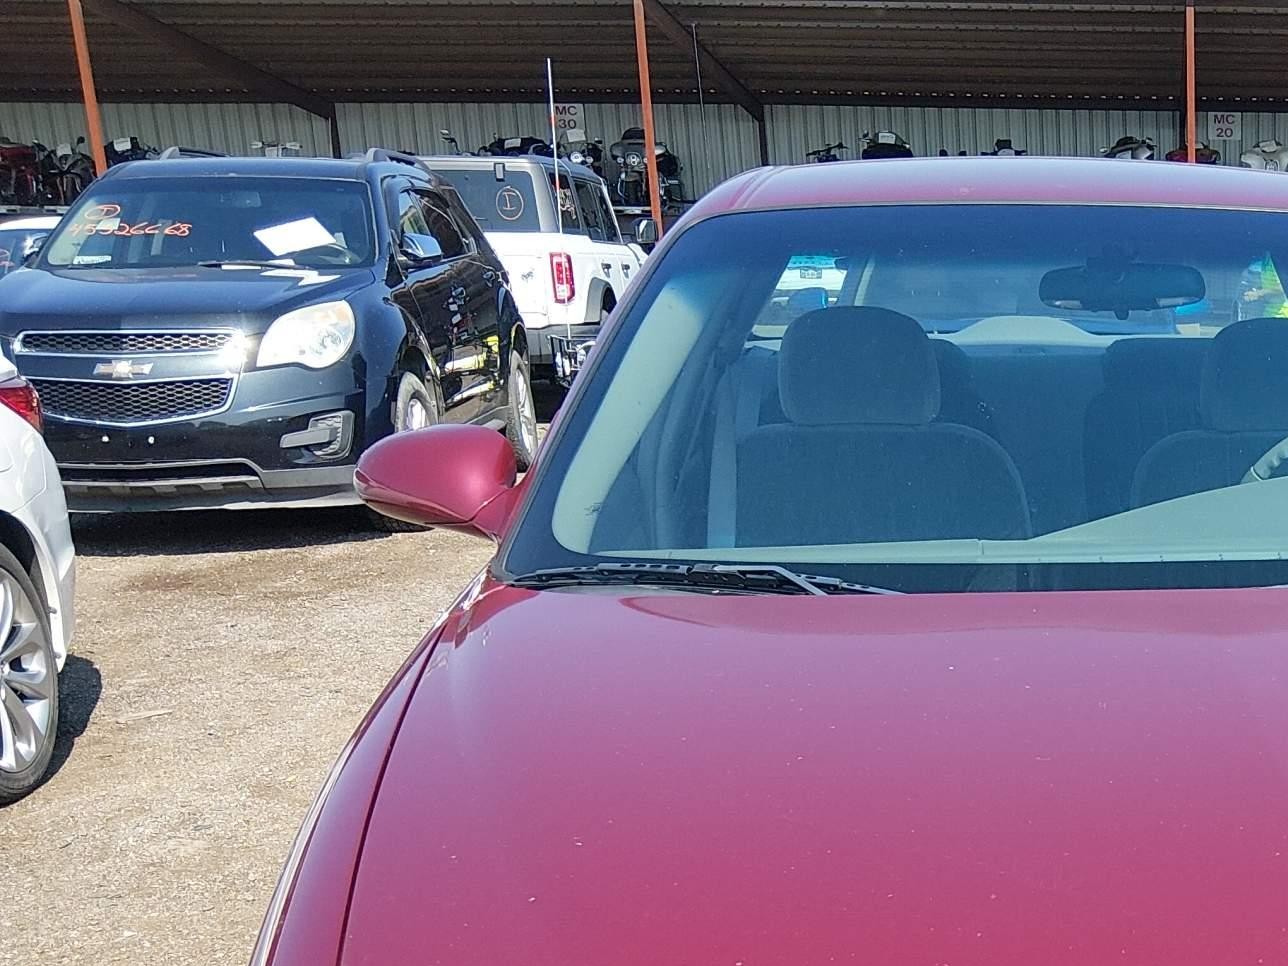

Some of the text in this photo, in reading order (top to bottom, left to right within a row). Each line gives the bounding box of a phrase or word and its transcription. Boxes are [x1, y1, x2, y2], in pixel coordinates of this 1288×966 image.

[555, 105, 577, 116] MC
[558, 118, 577, 129] 30
[1213, 113, 1235, 124] MC
[1215, 127, 1234, 138] 20
